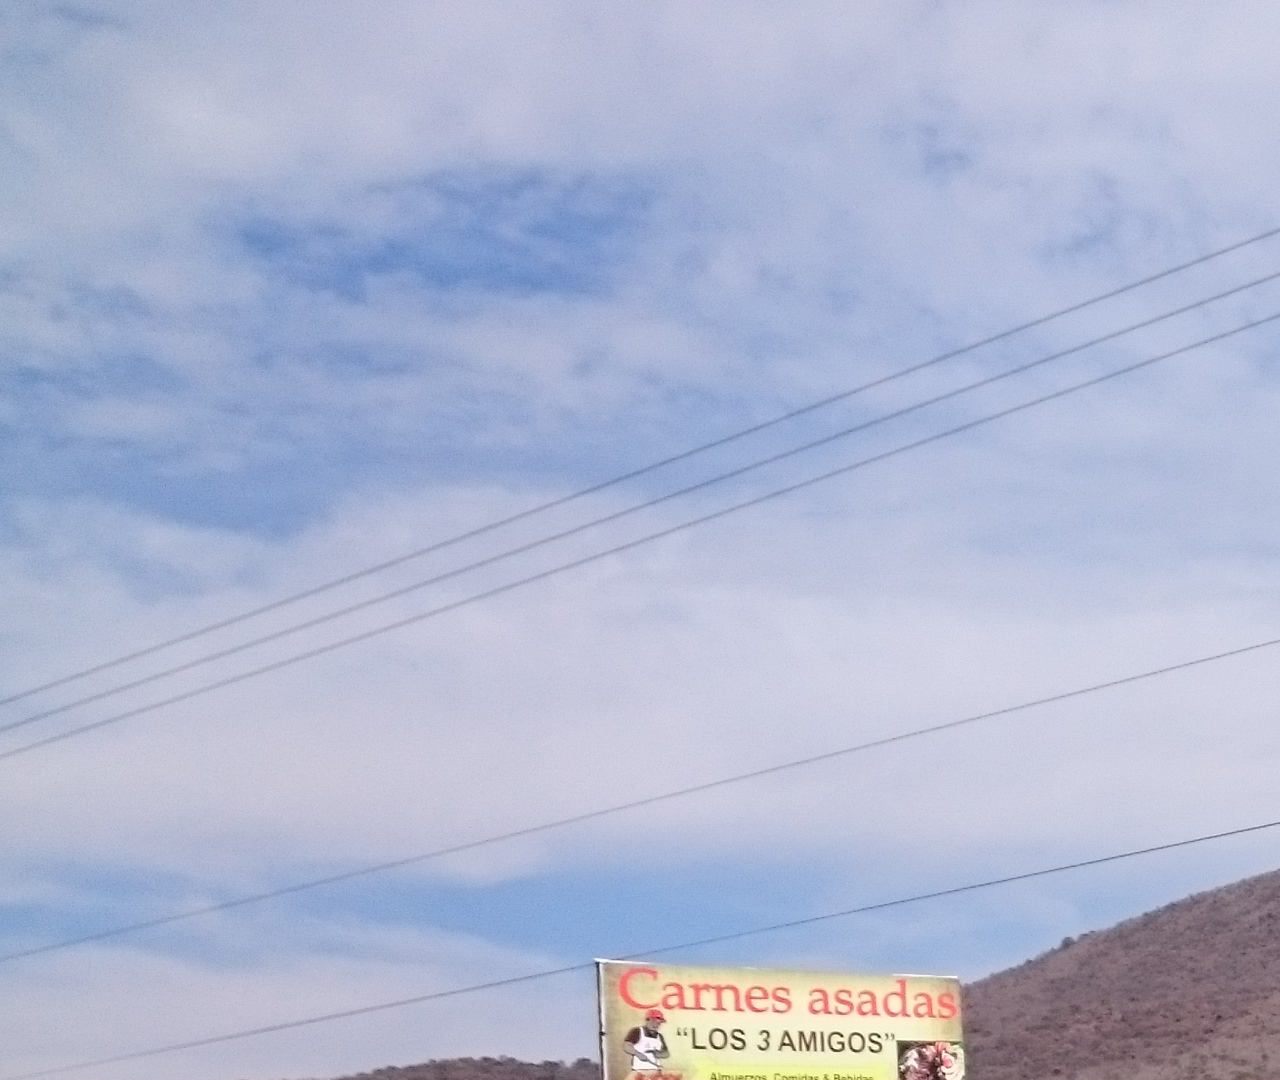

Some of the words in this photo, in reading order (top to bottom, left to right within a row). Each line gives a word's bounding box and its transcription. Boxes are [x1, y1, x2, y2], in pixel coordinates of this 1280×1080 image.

[618, 967, 792, 1014] Carnes
[807, 979, 958, 1020] asadas
[676, 1027, 746, 1051] “LOS
[757, 1029, 771, 1051] 3
[778, 1030, 896, 1053] AMIGOS”
